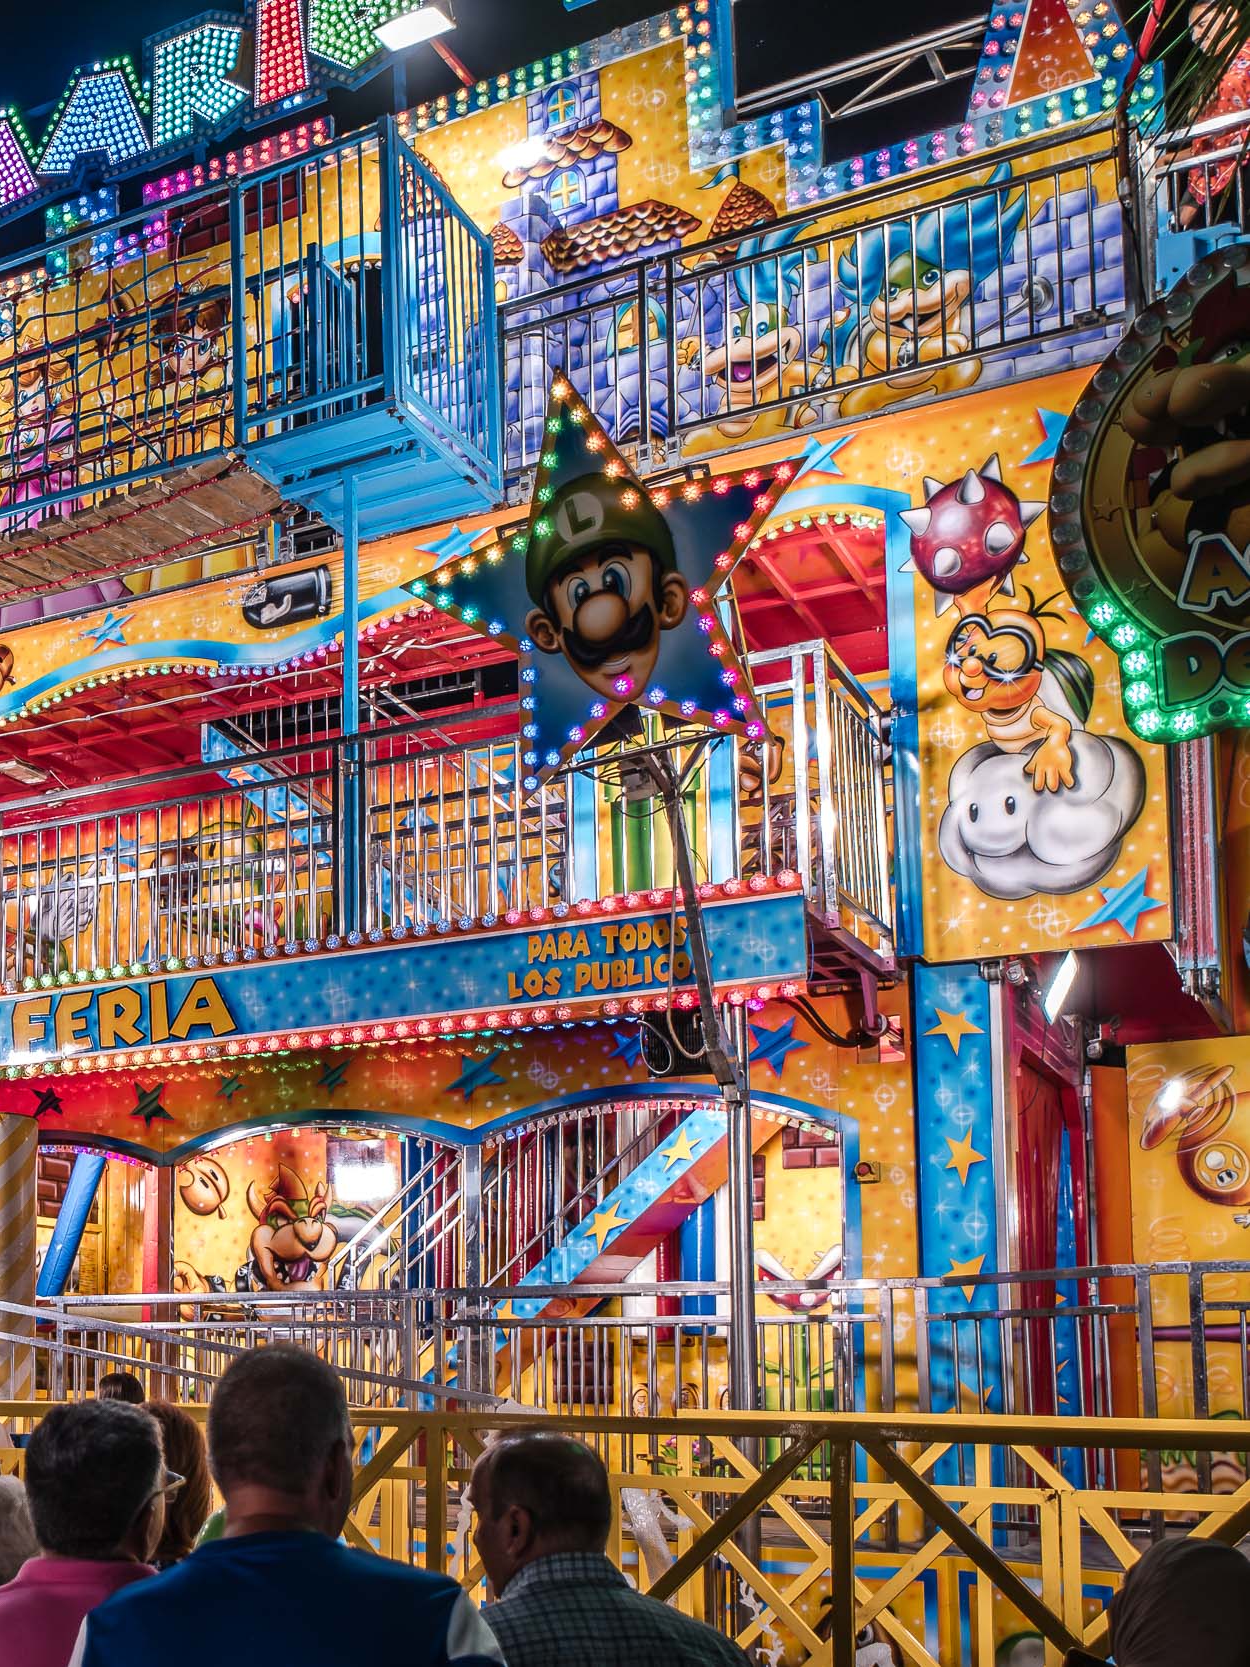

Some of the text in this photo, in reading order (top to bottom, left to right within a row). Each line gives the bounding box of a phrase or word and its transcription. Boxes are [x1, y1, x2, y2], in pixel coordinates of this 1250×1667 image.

[1177, 533, 1250, 612] A
[527, 916, 688, 964] PARA TODOS
[507, 949, 713, 999] LOS PUBLICO
[10, 977, 237, 1056] FERIA
